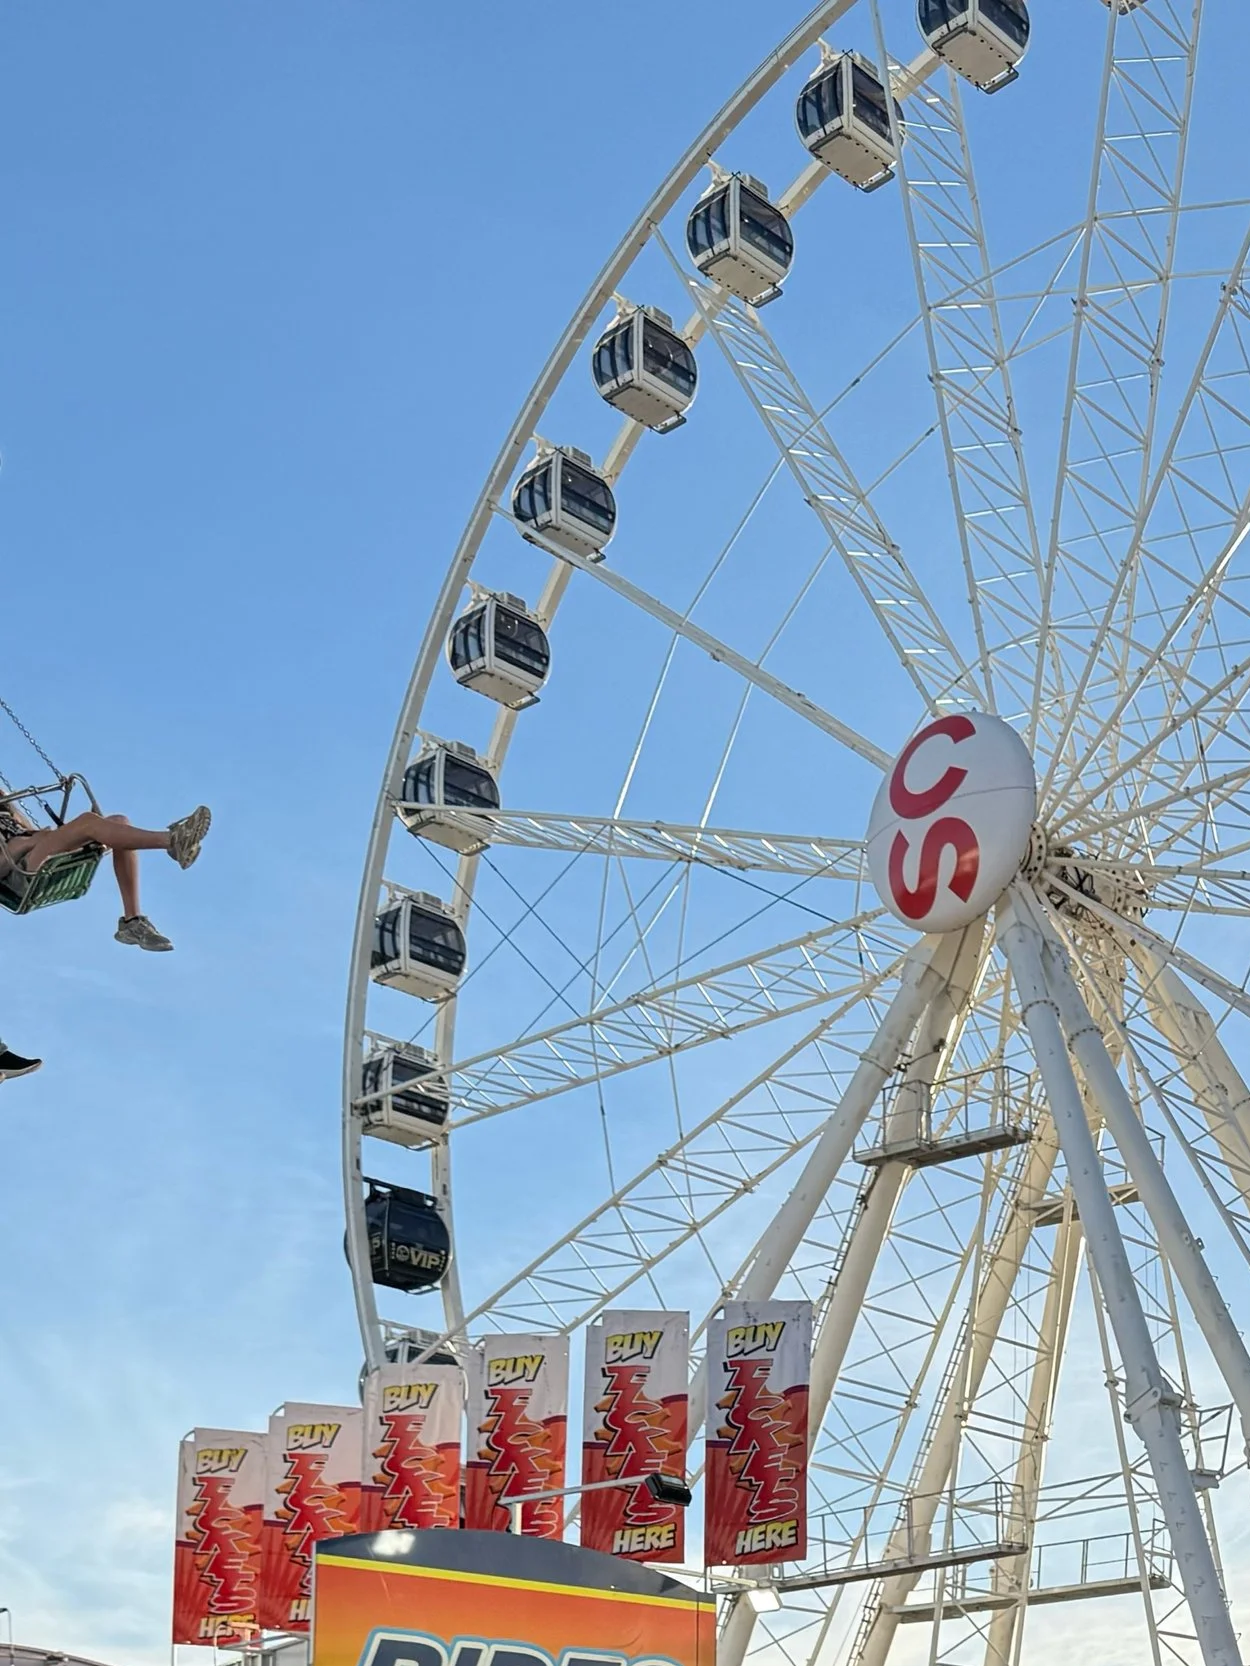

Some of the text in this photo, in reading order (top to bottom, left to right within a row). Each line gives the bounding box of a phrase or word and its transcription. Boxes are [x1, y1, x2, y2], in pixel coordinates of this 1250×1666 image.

[409, 1246, 441, 1269] VIP
[605, 1330, 663, 1364] BUY
[727, 1321, 786, 1358] BUY
[487, 1355, 545, 1387] BUY
[382, 1383, 438, 1413] BUY
[287, 1423, 341, 1450] BUY
[196, 1448, 248, 1474] BUY
[612, 1522, 677, 1556] HERE
[735, 1519, 799, 1557] HERE
